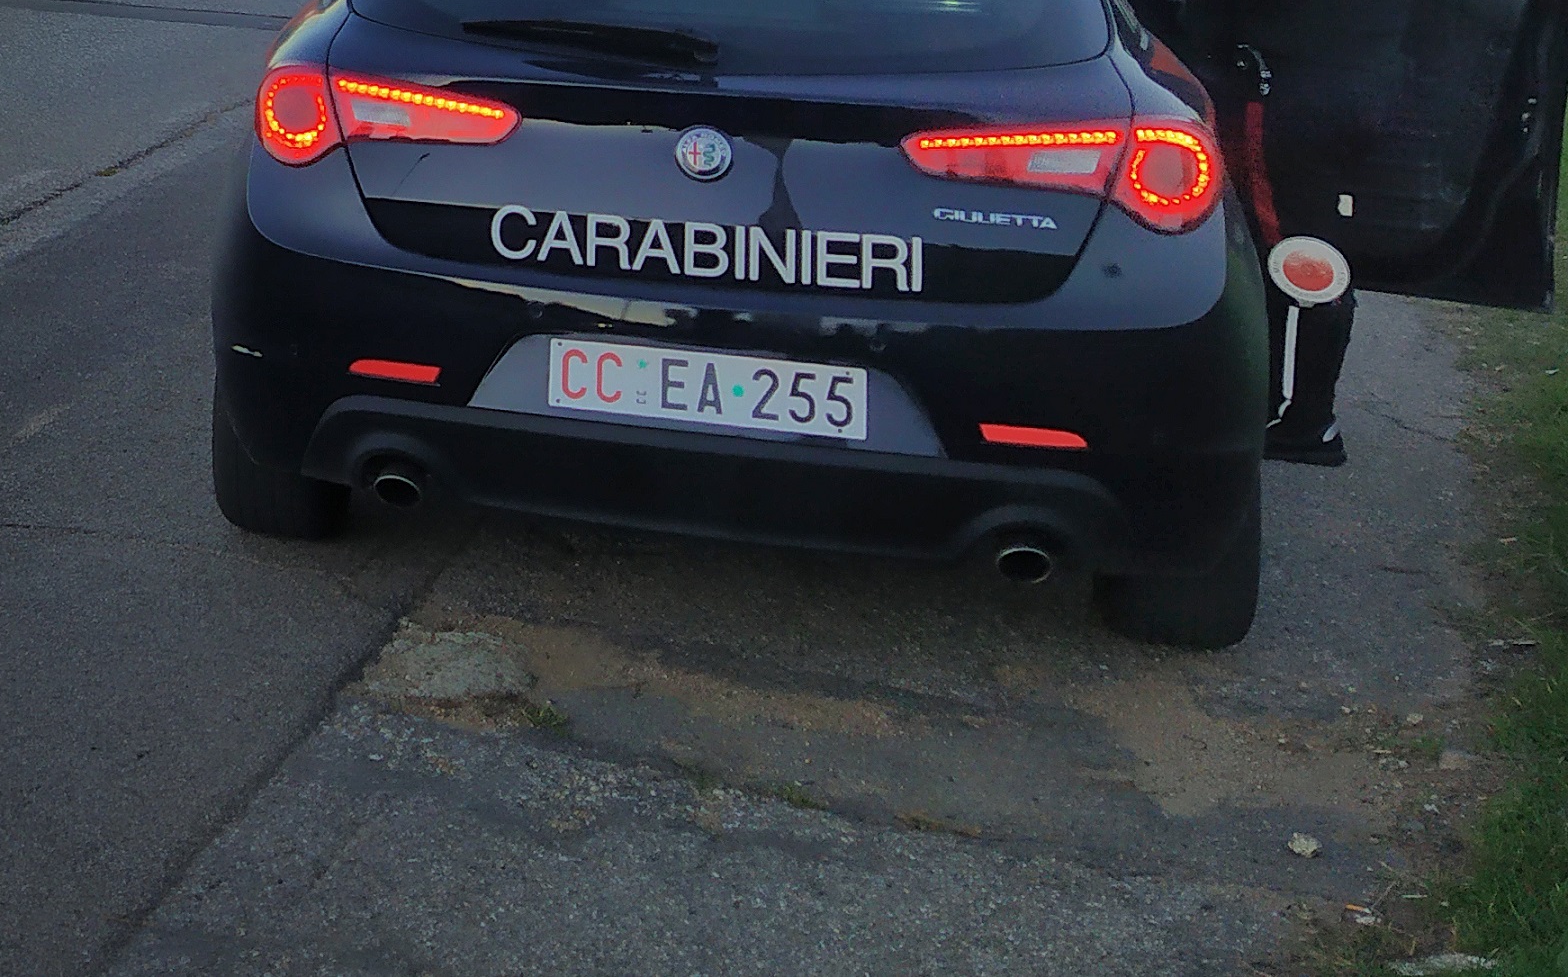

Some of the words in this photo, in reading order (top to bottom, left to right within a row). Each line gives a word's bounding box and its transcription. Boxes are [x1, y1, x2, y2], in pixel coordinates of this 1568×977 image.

[491, 204, 922, 292] CARABINIERI
[933, 208, 1057, 230] GIULIETTA
[561, 349, 623, 403] CC
[661, 358, 723, 415] EA
[751, 368, 854, 428] 255
